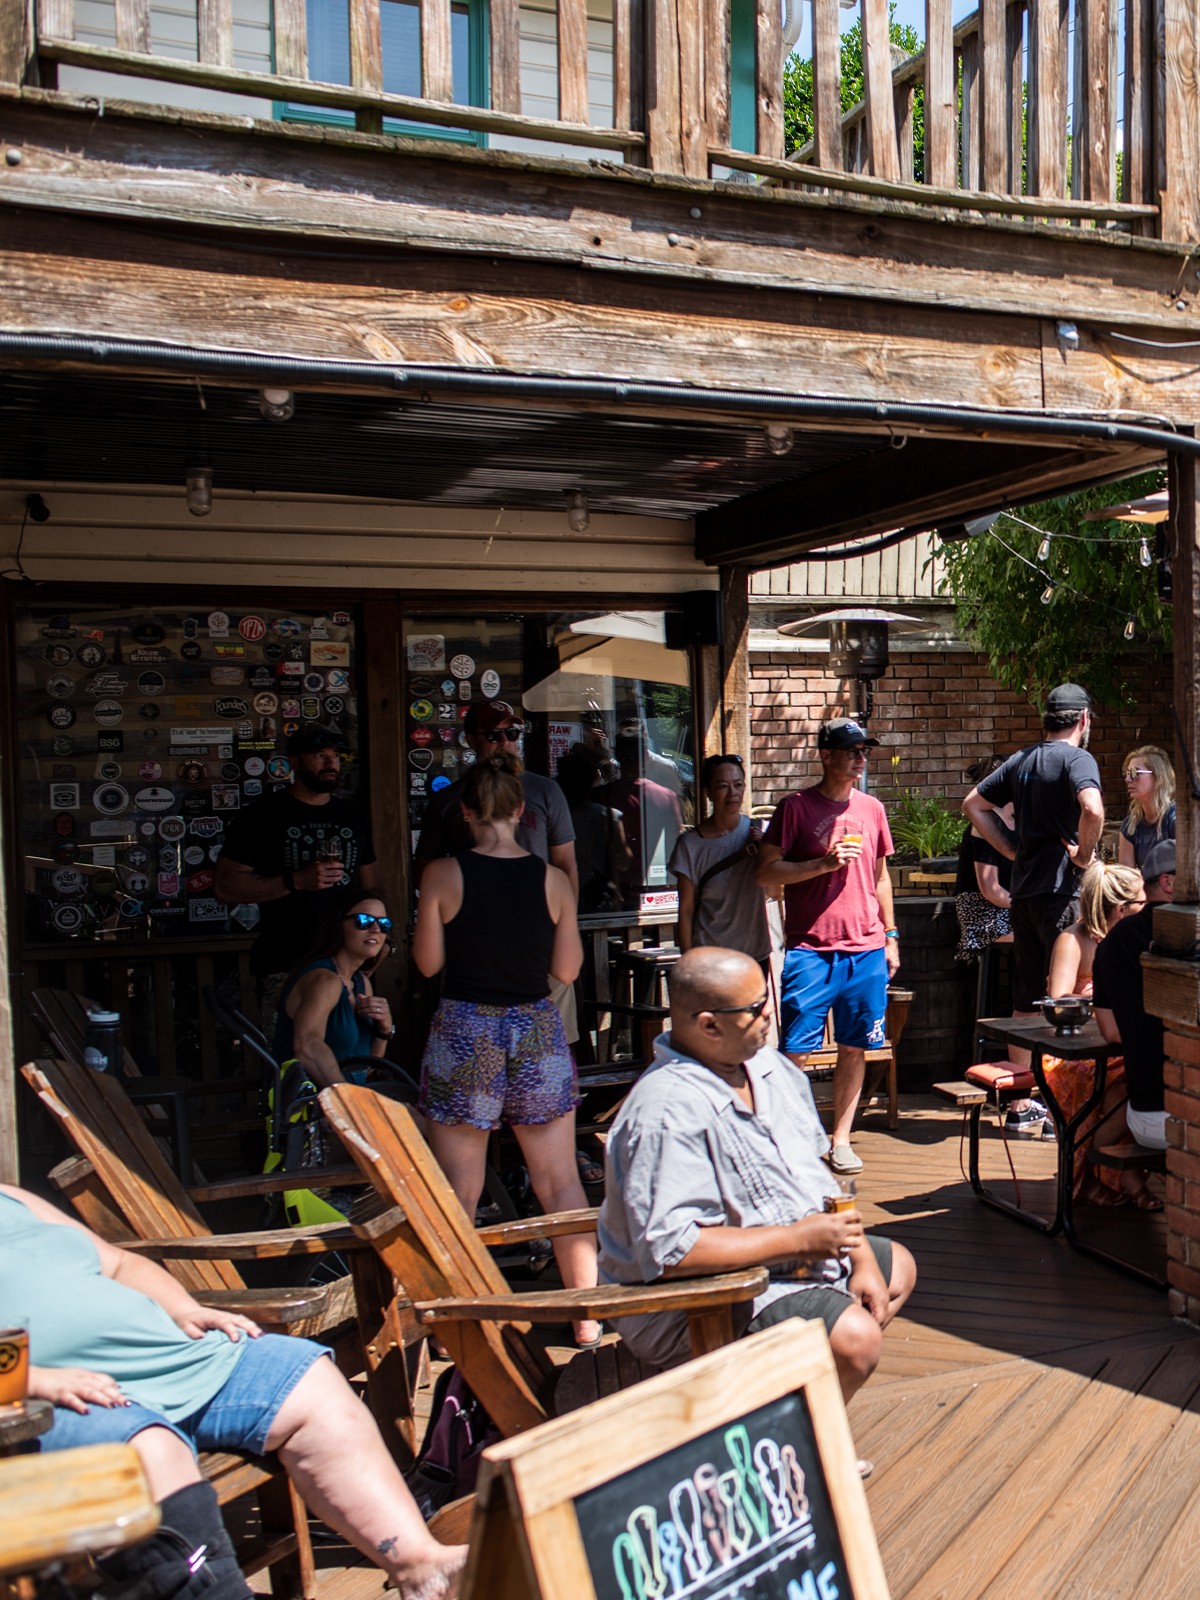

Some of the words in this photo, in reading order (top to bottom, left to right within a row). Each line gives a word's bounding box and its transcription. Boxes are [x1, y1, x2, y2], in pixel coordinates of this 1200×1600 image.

[215, 698, 248, 714] Founders
[99, 738, 121, 747] BSG
[169, 747, 208, 756] BUNKER
